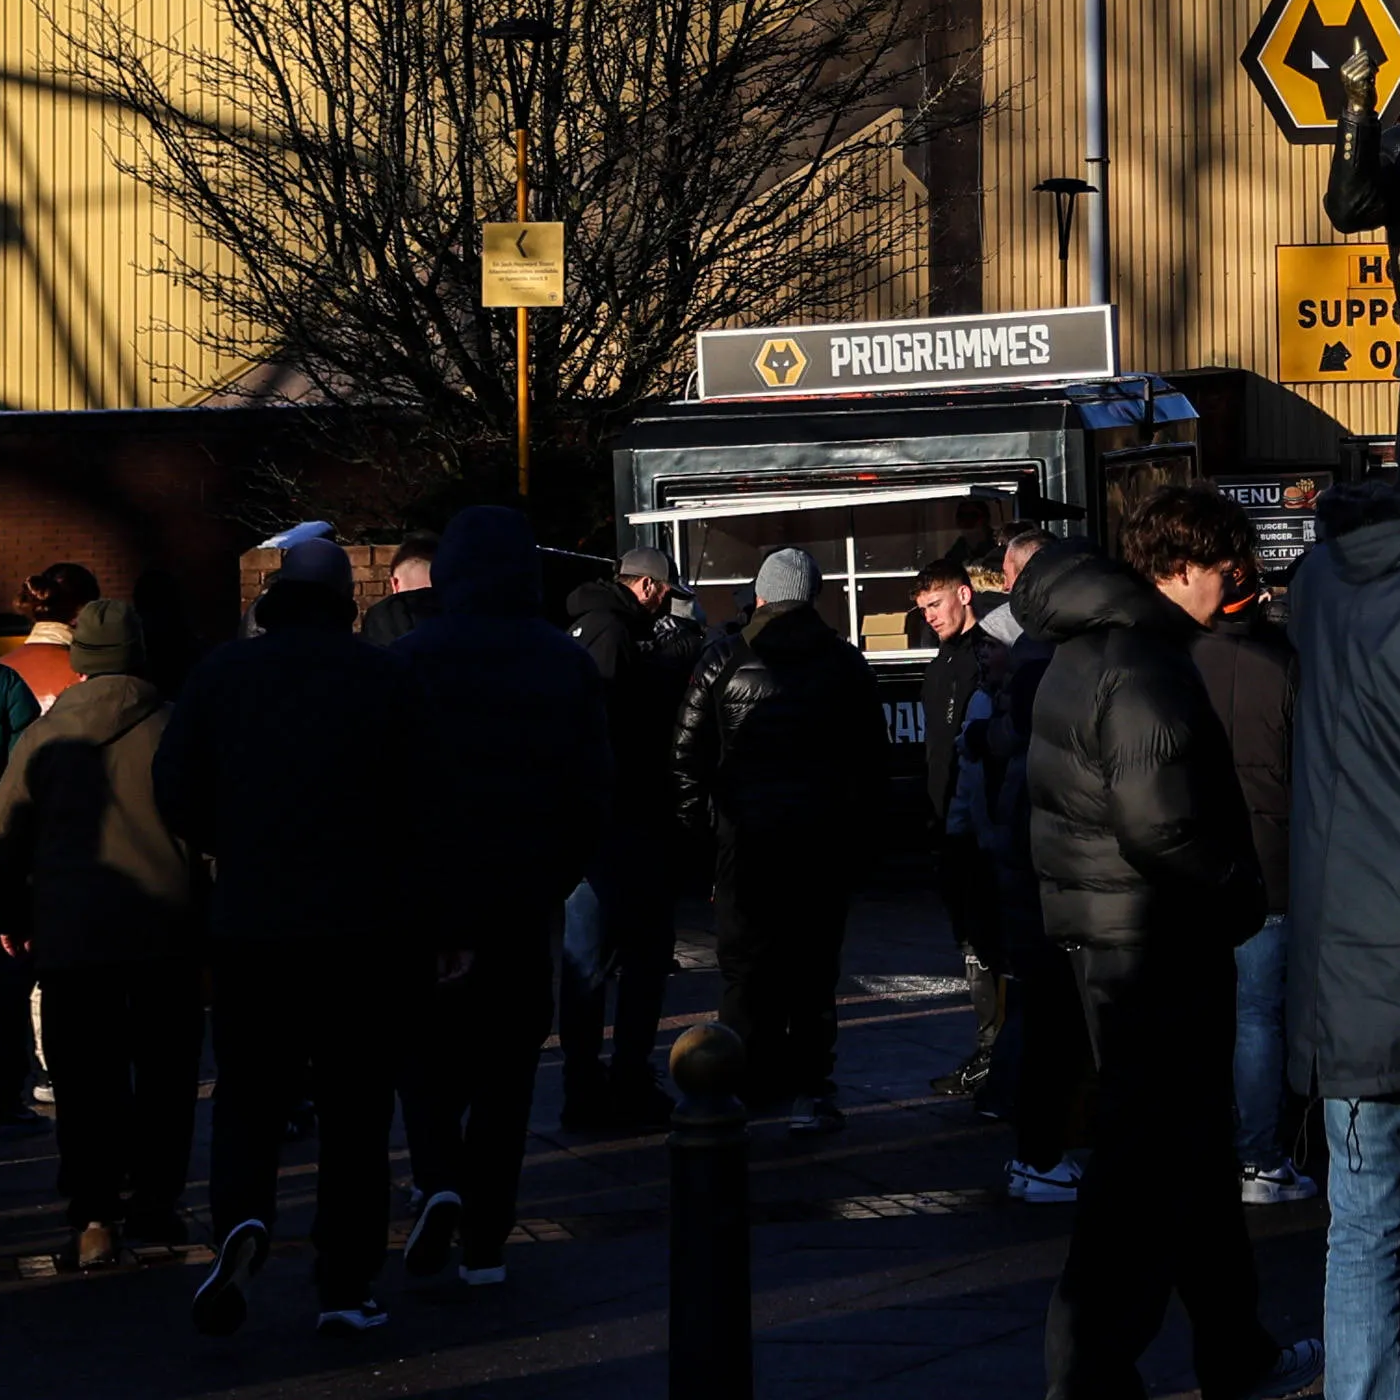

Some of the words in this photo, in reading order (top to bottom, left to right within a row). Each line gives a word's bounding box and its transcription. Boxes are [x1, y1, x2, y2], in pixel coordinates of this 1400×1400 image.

[1359, 256, 1394, 284] H
[1298, 298, 1400, 329] SUPP
[830, 324, 1050, 377] PROGRAMMES
